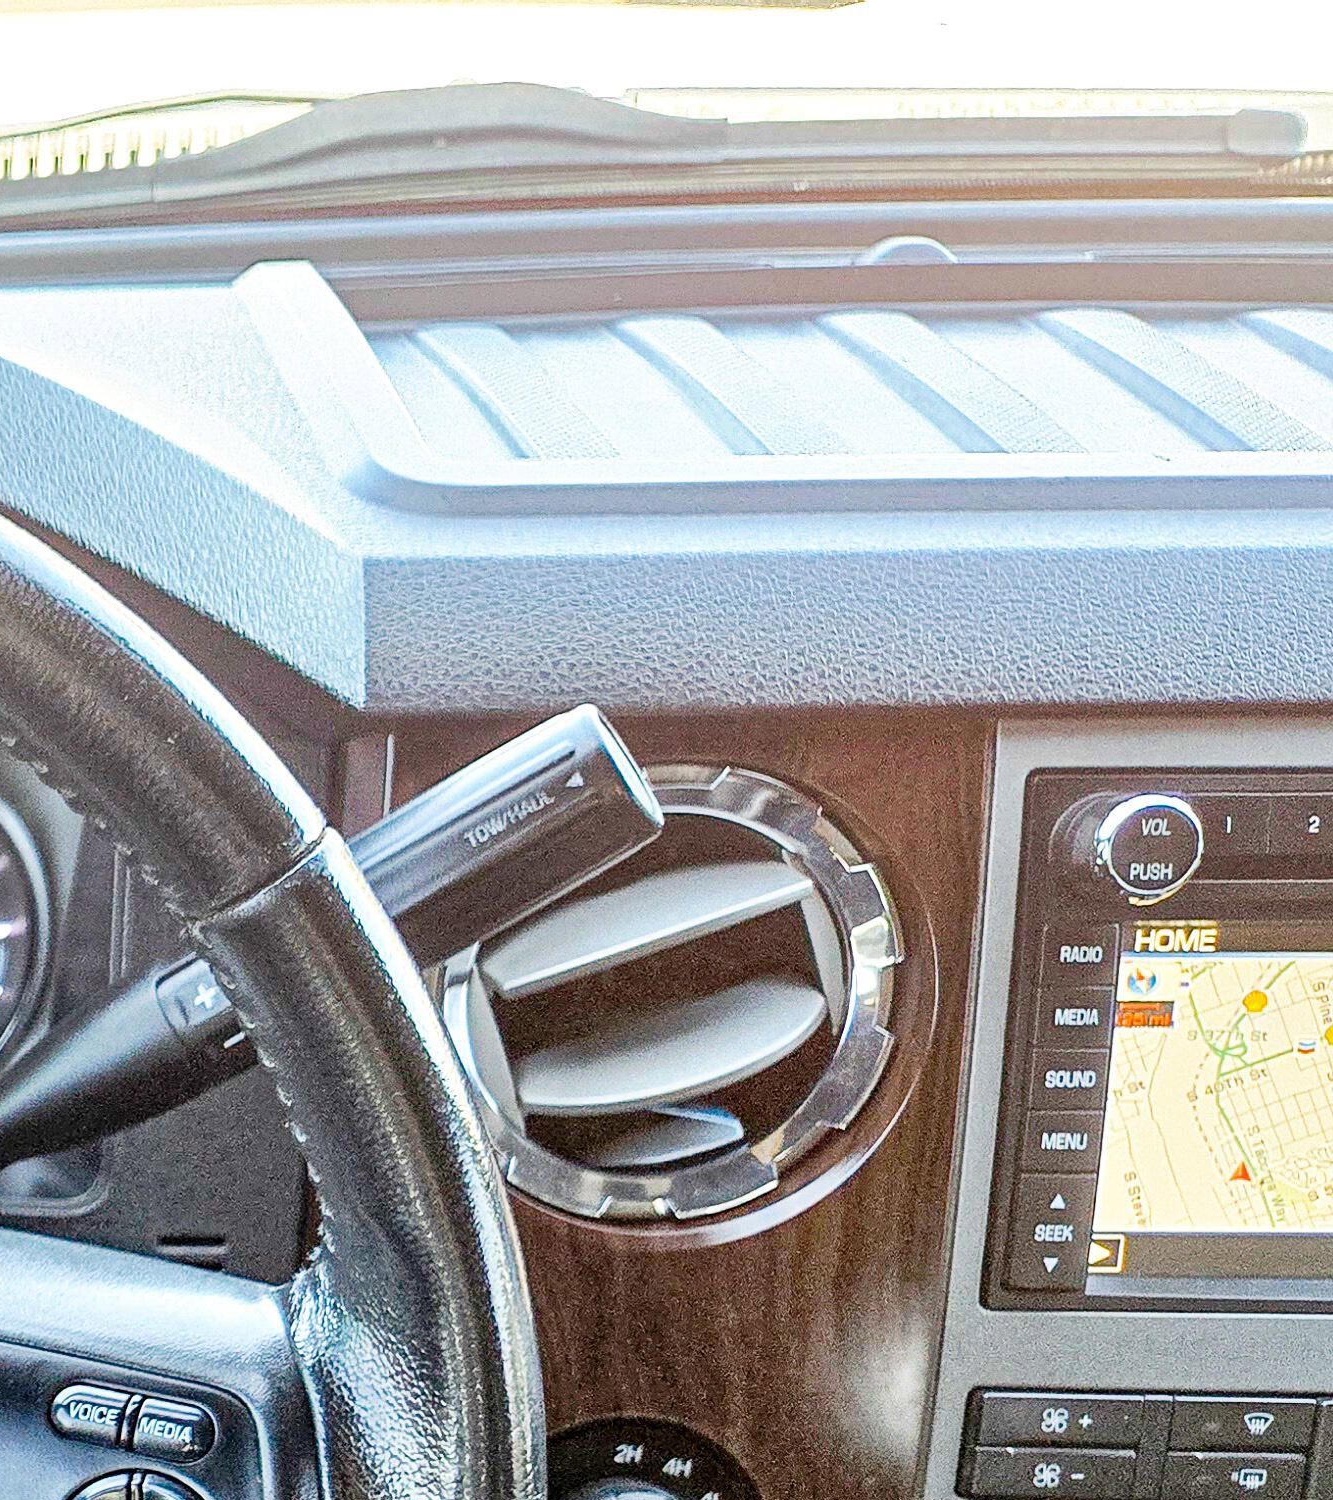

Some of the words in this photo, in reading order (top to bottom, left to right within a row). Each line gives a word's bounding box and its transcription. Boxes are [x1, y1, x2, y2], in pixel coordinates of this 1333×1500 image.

[1141, 818, 1171, 836] VOL
[1225, 816, 1232, 834] 1
[1308, 816, 1321, 834] 2
[1130, 863, 1173, 881] PUSH
[1134, 928, 1218, 952] HOME
[1060, 945, 1103, 963] RADIO
[1054, 1008, 1099, 1027] MEDIA
[1045, 1070, 1096, 1089] SOUND
[1041, 1133, 1088, 1151] MENU
[1034, 1225, 1074, 1243] SEEK
[68, 1401, 122, 1426] VOICE
[137, 1417, 192, 1443] MEDIA
[613, 1443, 645, 1464] 2H
[662, 1457, 693, 1479] 4H
